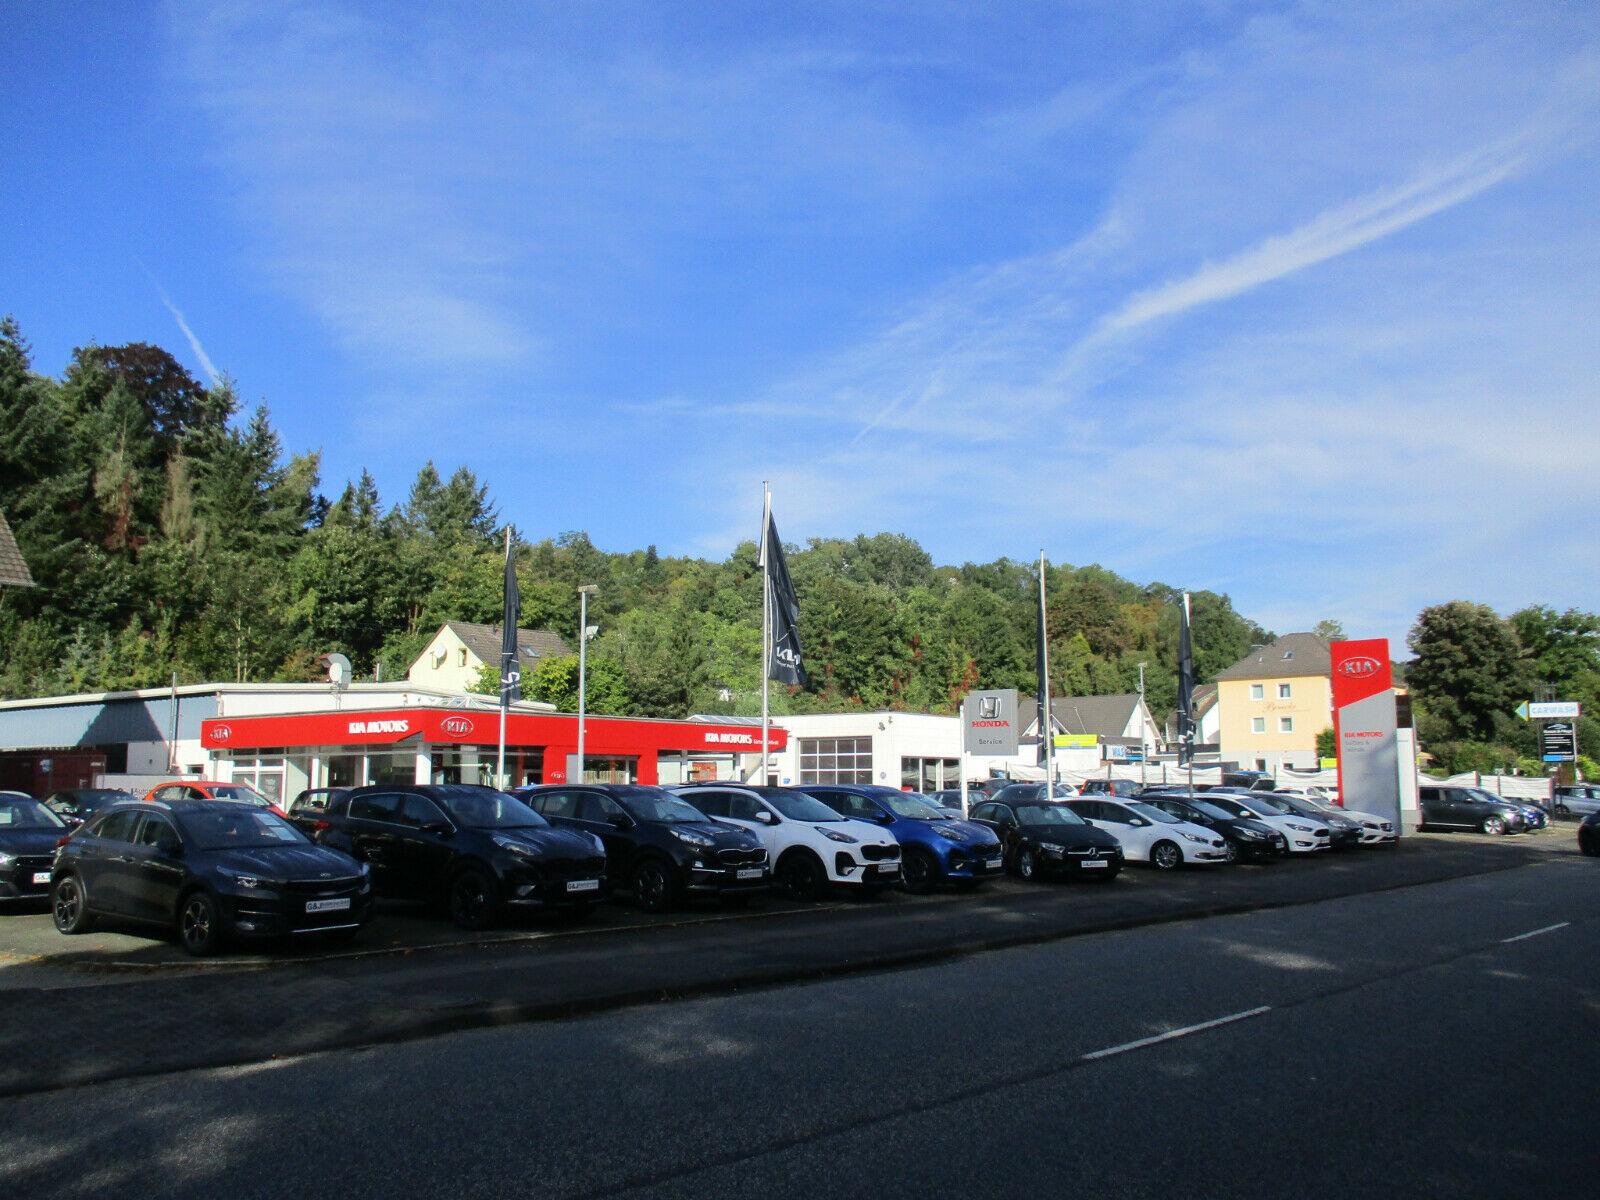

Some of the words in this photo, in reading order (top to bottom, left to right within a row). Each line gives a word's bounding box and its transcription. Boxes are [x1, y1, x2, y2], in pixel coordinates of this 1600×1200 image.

[1345, 661, 1373, 673] KIA
[1532, 706, 1577, 715] CARWASH
[349, 722, 367, 734] KIA
[367, 720, 409, 733] MOTORS
[447, 721, 467, 733] KIA
[972, 720, 1010, 728] HONDA
[213, 728, 229, 739] KIA
[705, 733, 719, 743] KIA
[720, 733, 753, 744] MOTORS
